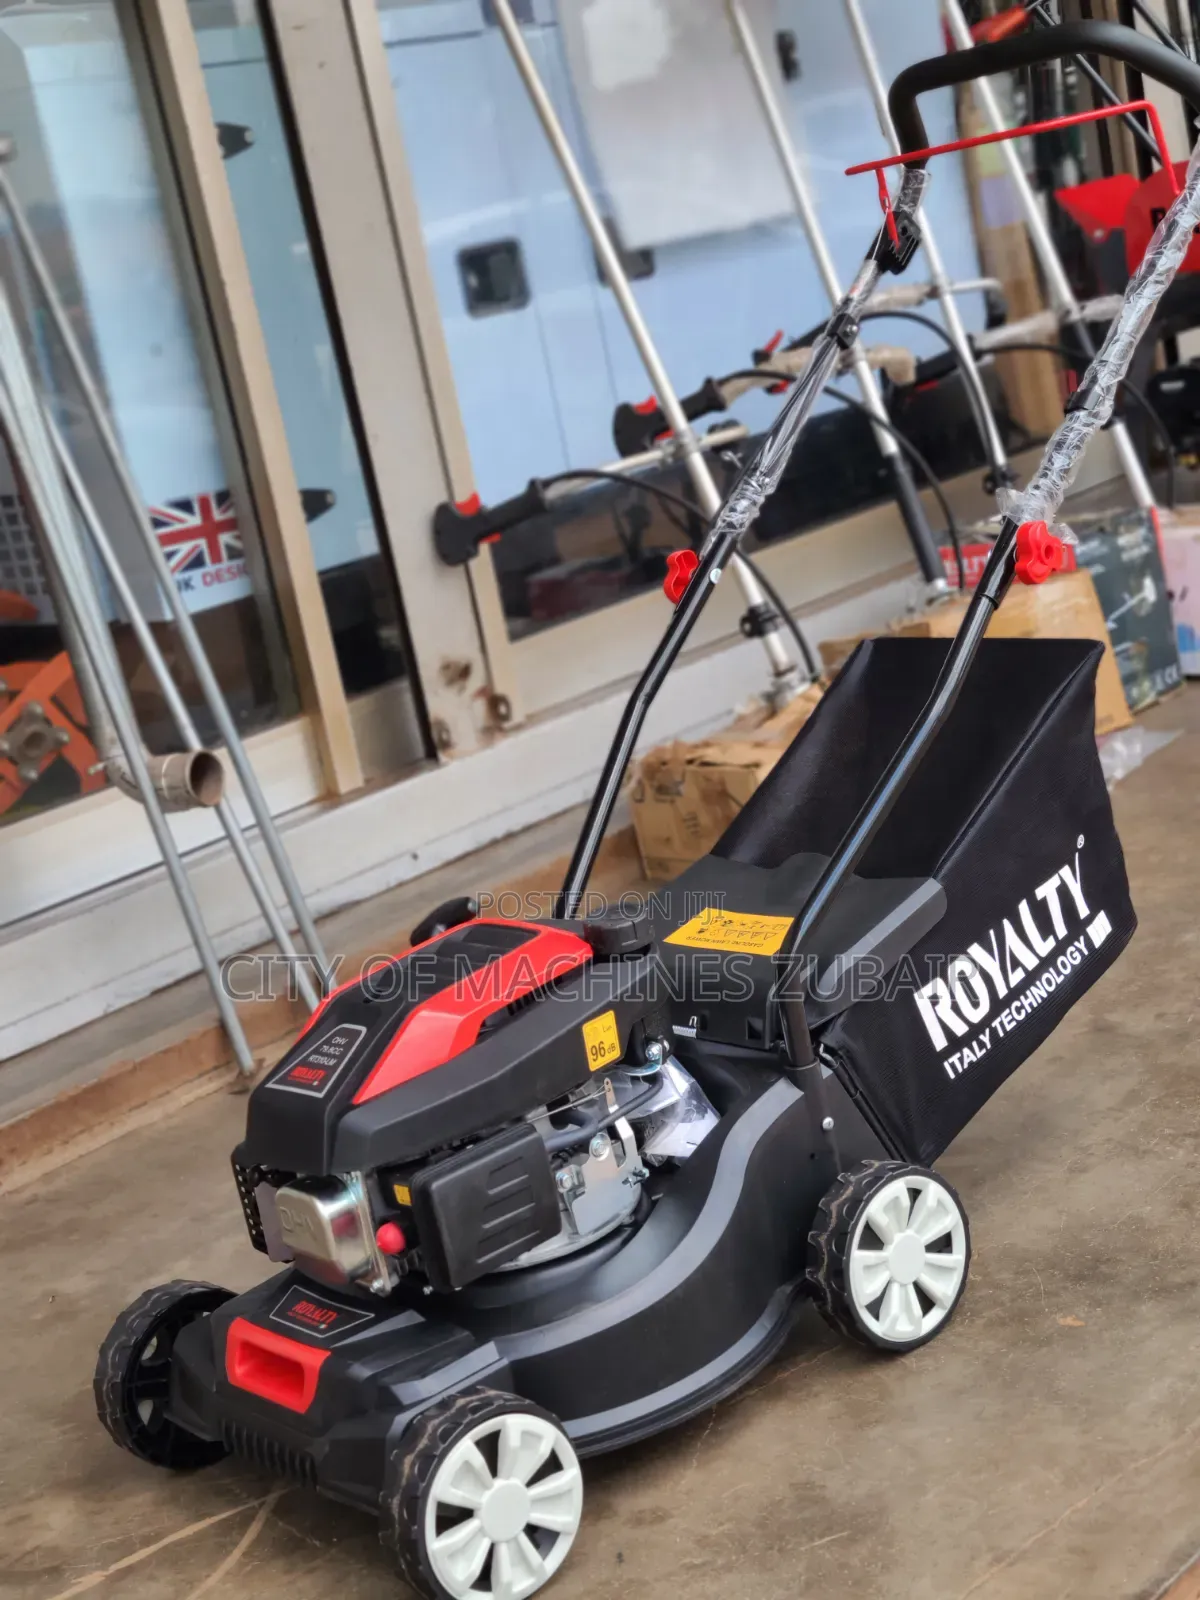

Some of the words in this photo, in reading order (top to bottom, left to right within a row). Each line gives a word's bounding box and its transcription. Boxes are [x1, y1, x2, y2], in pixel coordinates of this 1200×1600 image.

[913, 852, 1090, 1052] ROYALTY
[943, 1029, 992, 1080] ITALY
[991, 935, 1089, 1037] TECHNOLOGY
[332, 1036, 348, 1045] OHV
[590, 1041, 606, 1062] 96
[607, 1042, 617, 1054] dB
[292, 1301, 338, 1325] ROYALTY
